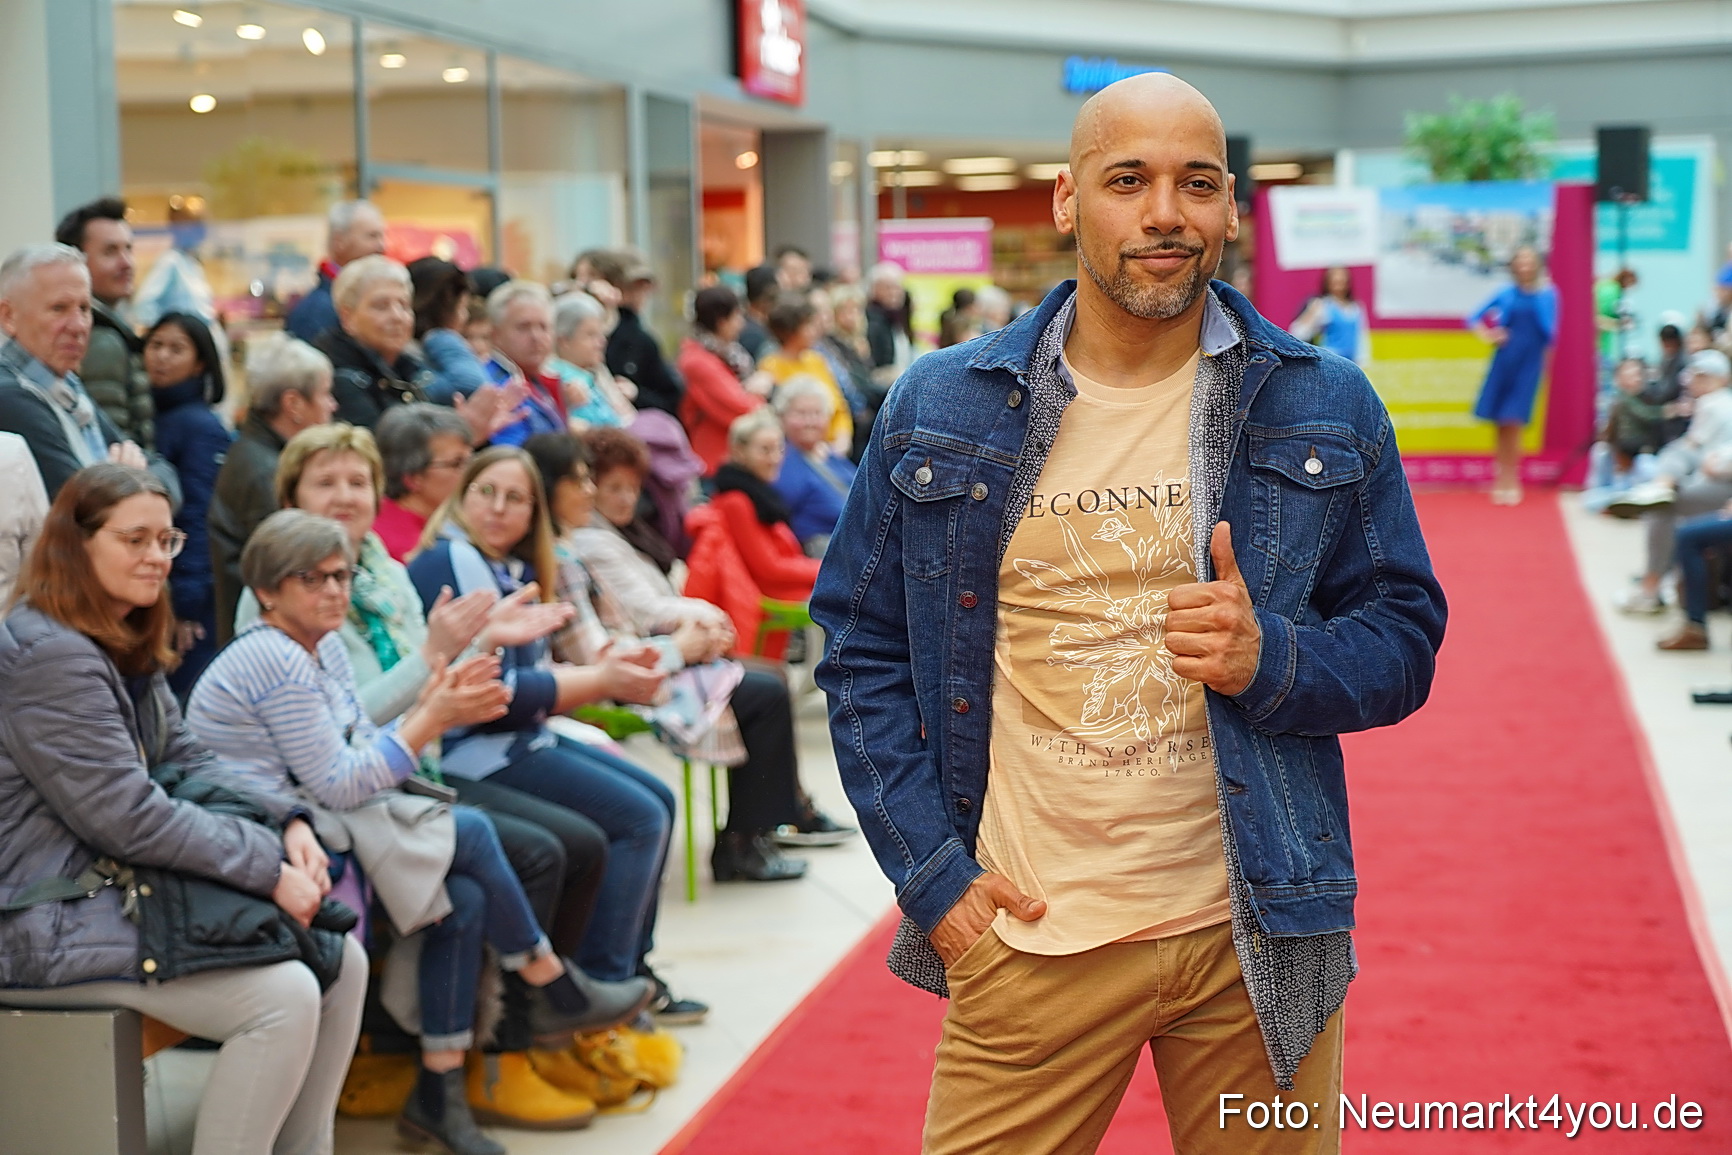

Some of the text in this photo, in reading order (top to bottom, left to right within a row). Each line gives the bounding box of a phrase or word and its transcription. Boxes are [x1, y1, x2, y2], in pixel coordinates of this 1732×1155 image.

[1020, 483, 1192, 519] ECONNE
[1030, 734, 1086, 756] WITH
[1058, 755, 1110, 767] BRAND
